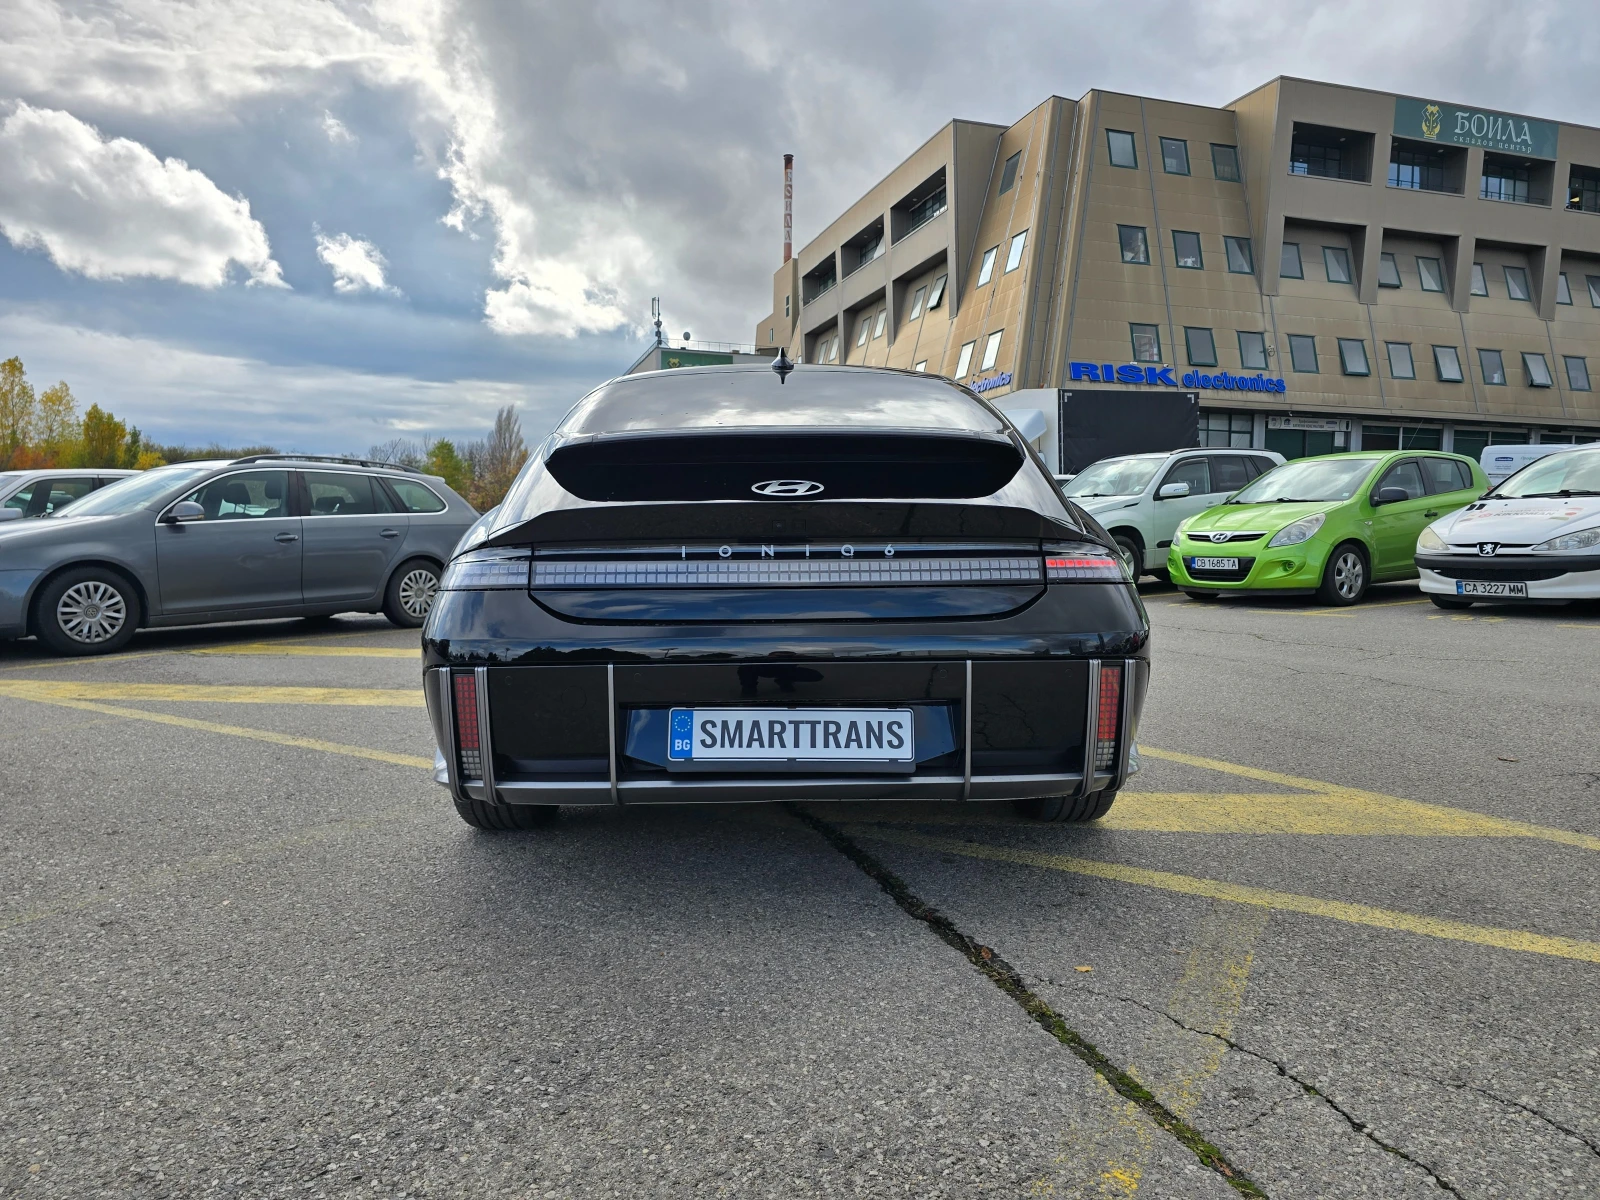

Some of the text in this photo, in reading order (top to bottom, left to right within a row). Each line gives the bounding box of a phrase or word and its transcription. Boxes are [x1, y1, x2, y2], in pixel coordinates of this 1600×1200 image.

[1454, 111, 1533, 145] БОИЛА
[1453, 136, 1532, 153] складов център
[969, 371, 1013, 393] lectronics
[1070, 361, 1286, 393] RISK electronics
[1207, 559, 1226, 568] 1685
[1480, 583, 1506, 594] 3227
[674, 719, 905, 751] BG SMARTTRANS
